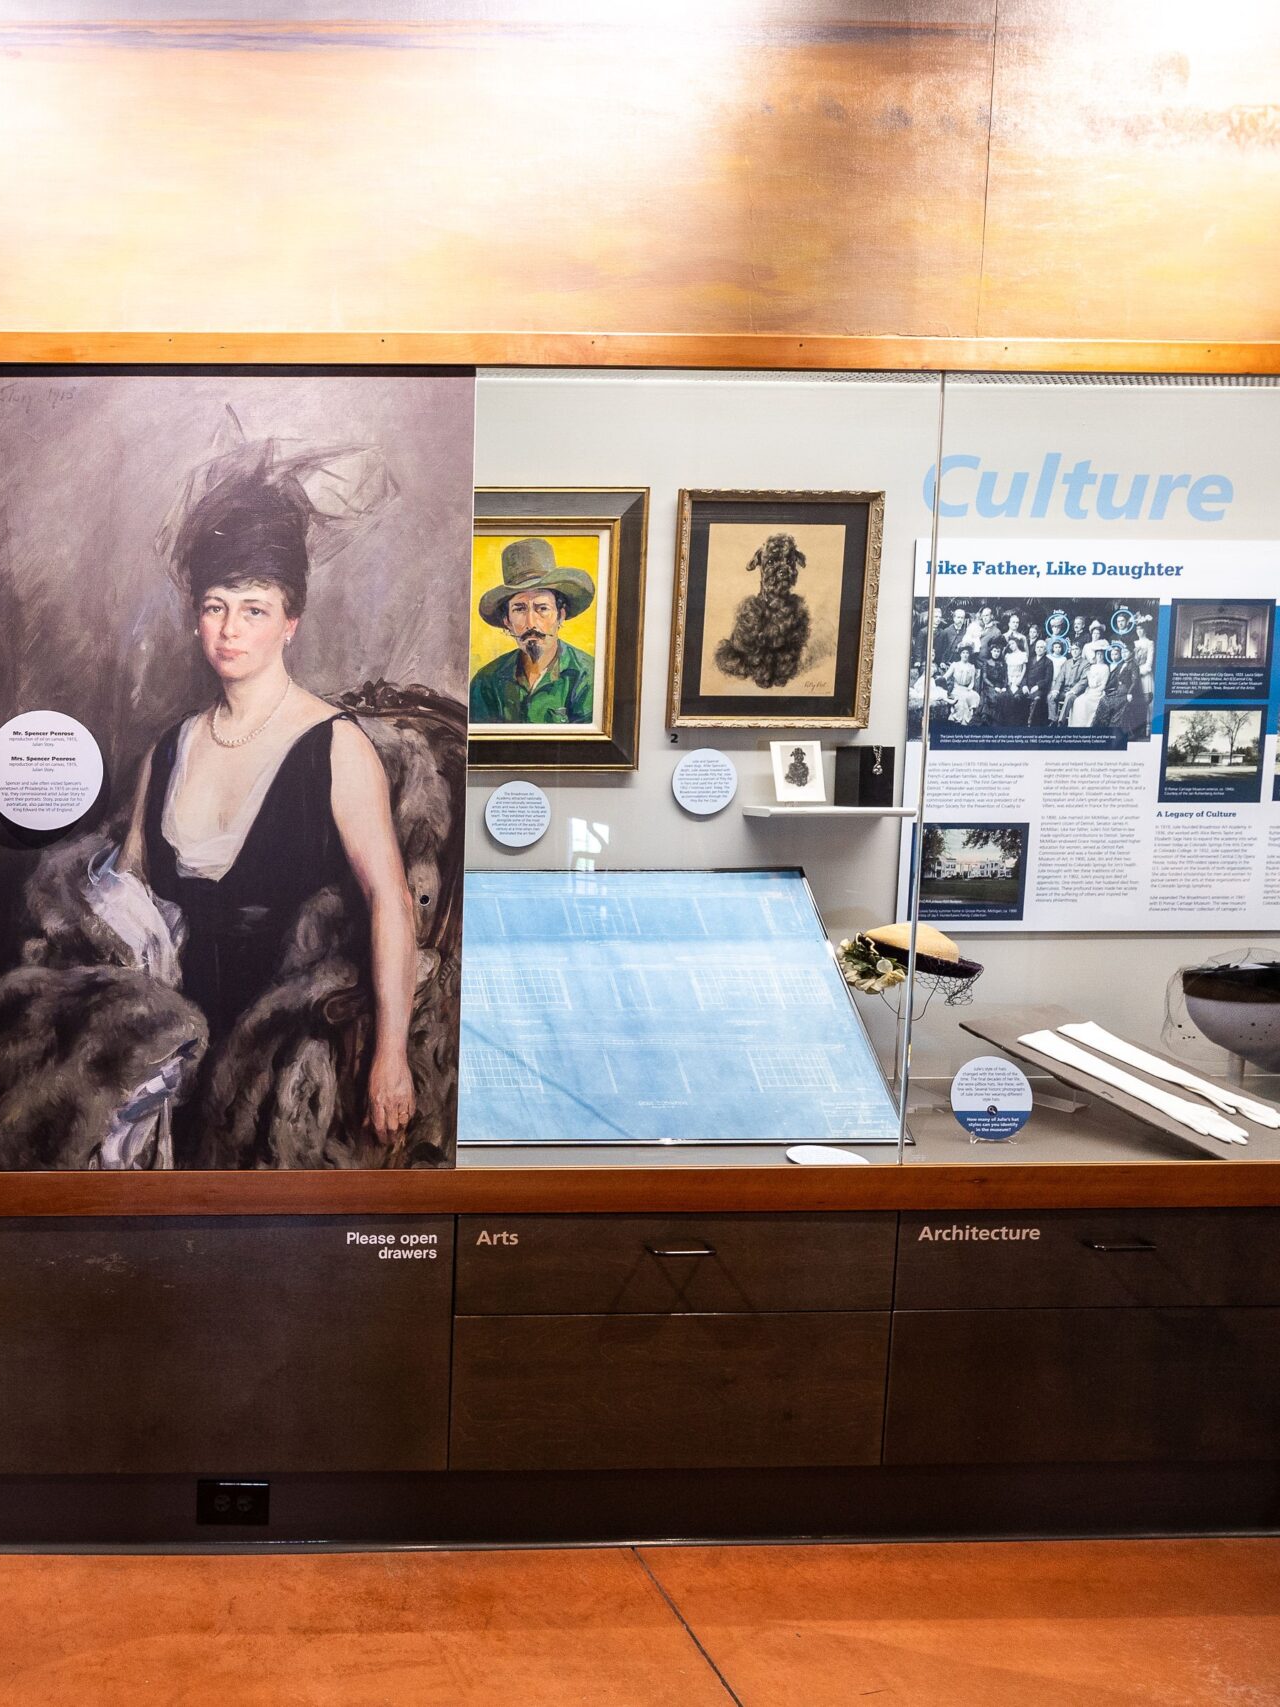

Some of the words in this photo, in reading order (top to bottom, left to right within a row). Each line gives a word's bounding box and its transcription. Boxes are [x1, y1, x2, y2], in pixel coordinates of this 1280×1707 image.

[922, 453, 1234, 522] Culture
[972, 561, 1040, 578] Father,
[1046, 561, 1086, 575] Like
[1092, 561, 1183, 579] Daughter
[670, 733, 678, 743] 2
[1165, 811, 1194, 819] Legacy
[347, 1232, 395, 1245] Please
[400, 1234, 437, 1249] open
[476, 1230, 518, 1245] Arts
[918, 1225, 1040, 1241] Architecture
[378, 1245, 437, 1259] drawers
